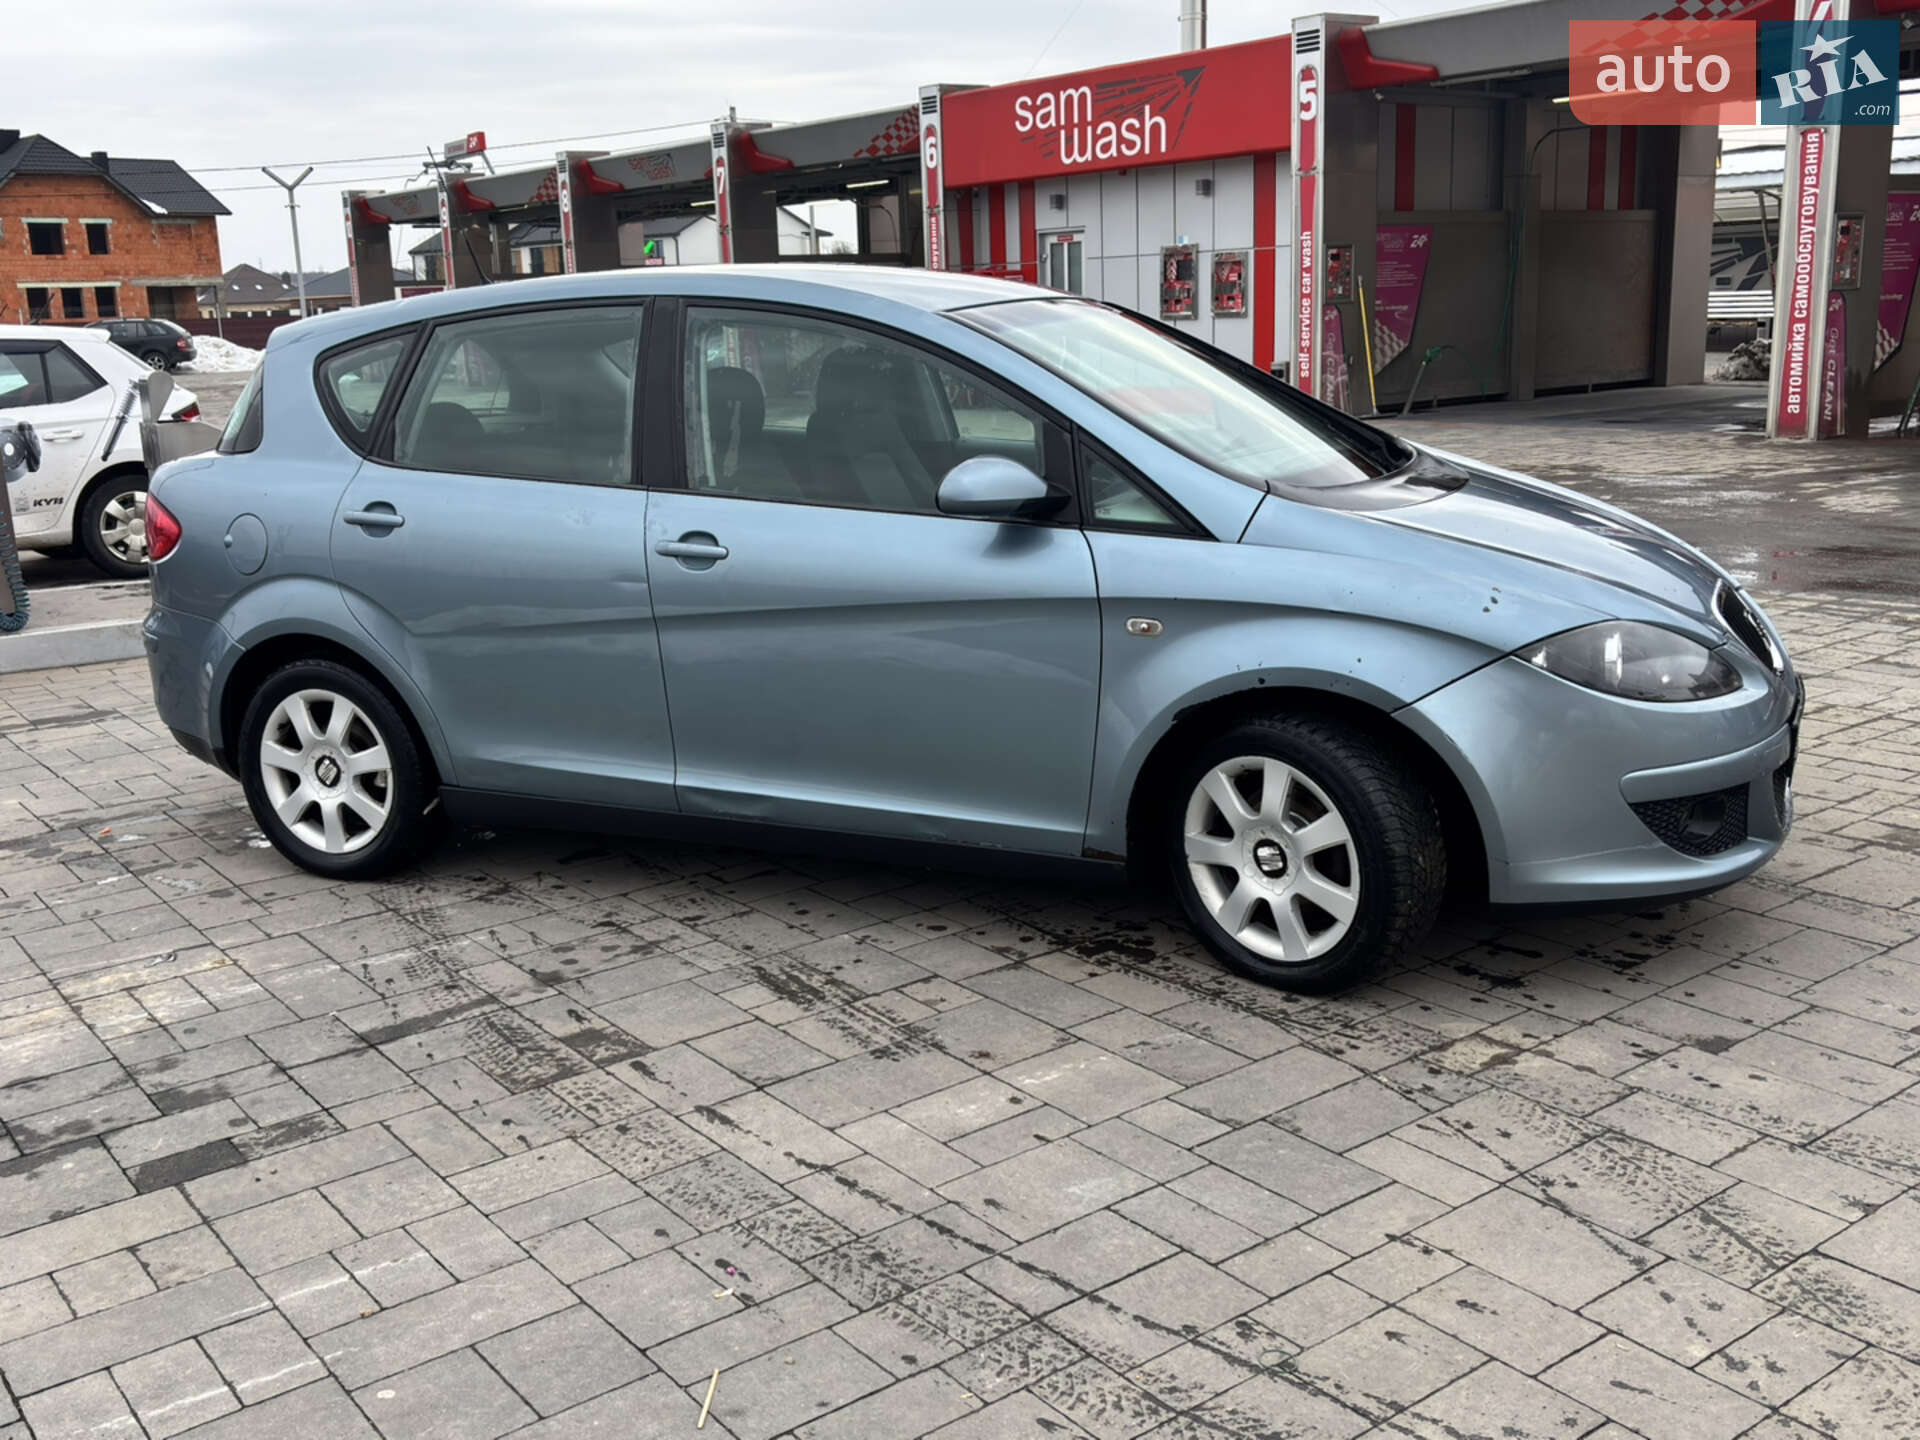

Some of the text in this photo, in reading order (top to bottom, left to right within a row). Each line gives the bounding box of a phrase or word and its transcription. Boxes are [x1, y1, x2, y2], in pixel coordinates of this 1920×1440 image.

[1014, 86, 1092, 132] sam
[1300, 79, 1318, 120] 5
[925, 136, 937, 169] 6
[1060, 104, 1166, 165] wash
[562, 189, 569, 212] 8
[716, 167, 725, 194] 7
[1786, 132, 1820, 414] автомийка самообслуговування
[1299, 231, 1312, 378] self-service car wash
